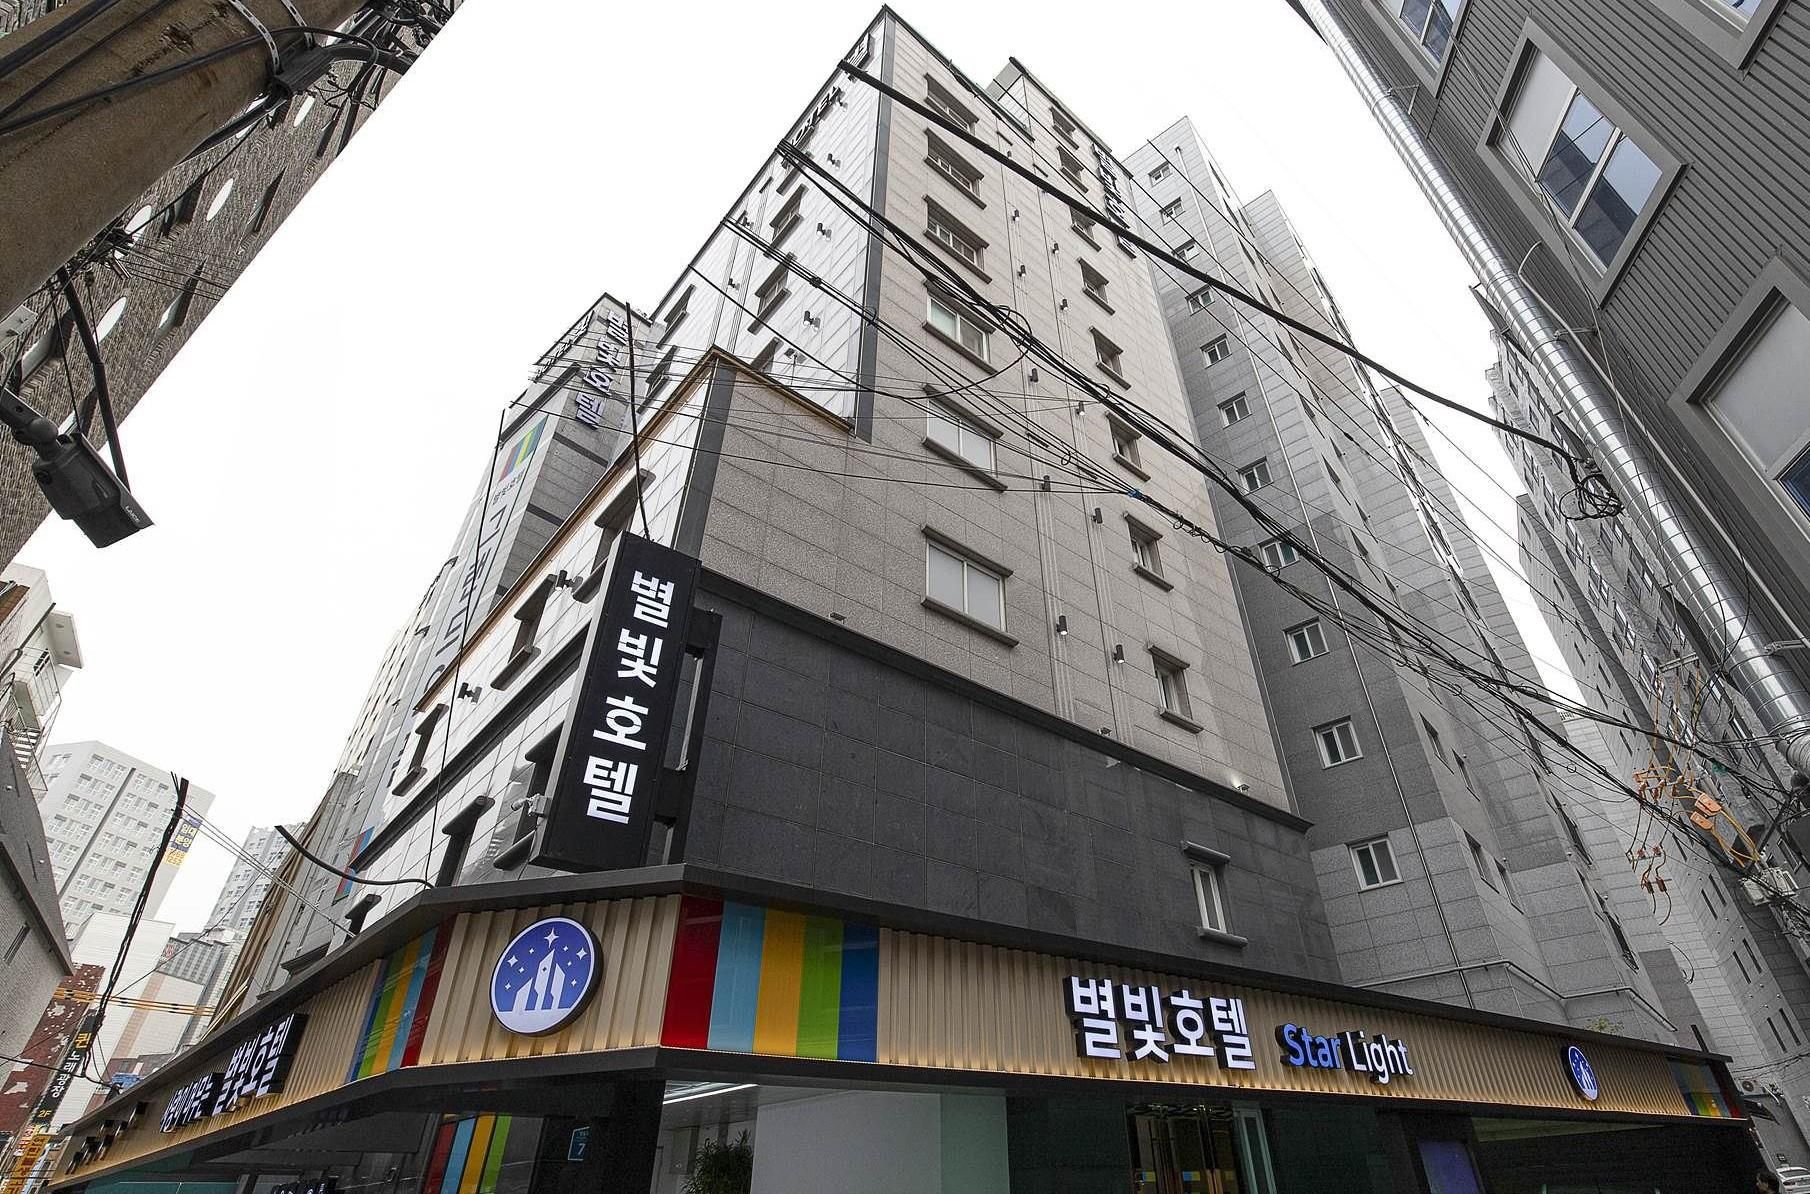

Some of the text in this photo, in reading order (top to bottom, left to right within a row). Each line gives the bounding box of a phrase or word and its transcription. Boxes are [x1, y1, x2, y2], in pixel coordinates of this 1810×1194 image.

[575, 308, 630, 426] 별빛호텔
[583, 570, 675, 825] 별빛호텔
[50, 1050, 81, 1098] 노래광장
[75, 1032, 92, 1049] 퀸
[211, 1013, 295, 1116] 별빛호텔
[1072, 976, 1414, 1085] 별빛호텔 Star Light
[38, 1109, 52, 1118] 2F
